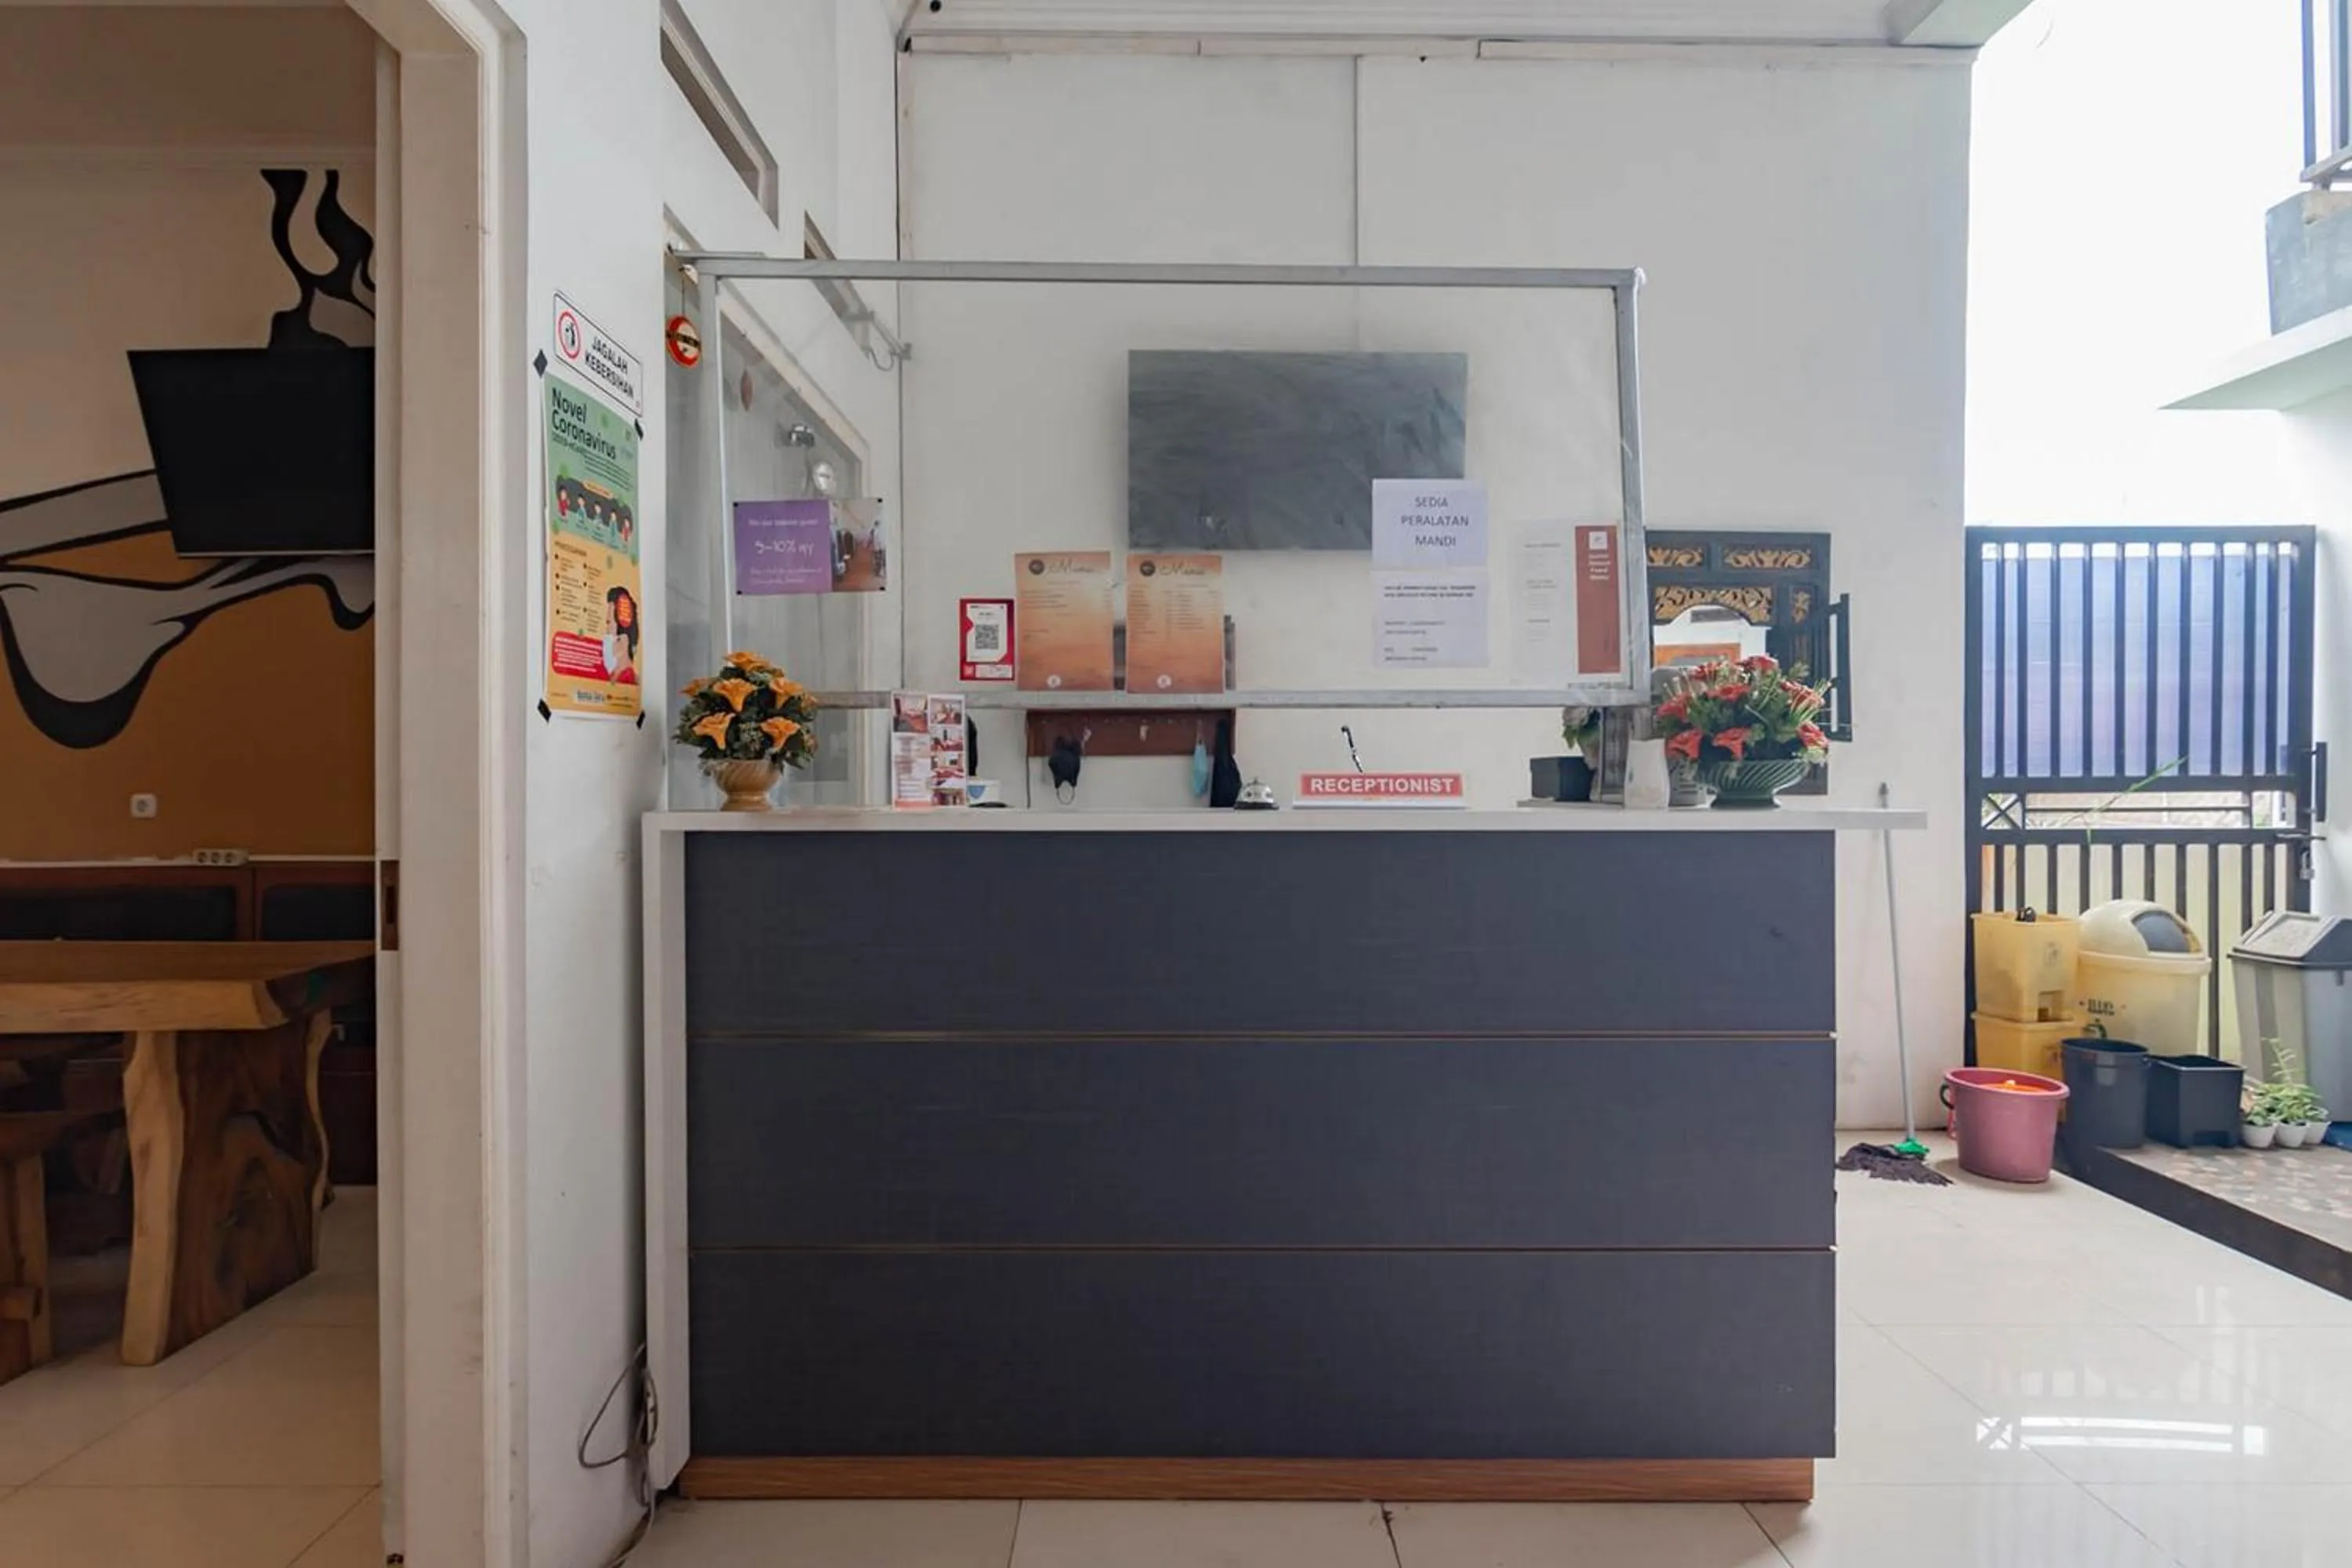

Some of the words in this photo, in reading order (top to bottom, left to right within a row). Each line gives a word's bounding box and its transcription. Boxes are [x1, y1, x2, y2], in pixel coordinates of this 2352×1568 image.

[592, 335, 628, 374] JAGALAH
[585, 350, 633, 399] KEBERSIHAN
[552, 387, 587, 423] Novel
[552, 409, 615, 460] Coronavirus
[1415, 496, 1448, 507] SEDIA
[1401, 515, 1468, 526] PERALATAN
[1415, 535, 1456, 546] MANDI
[1310, 777, 1455, 793] RECEPTIONIST
